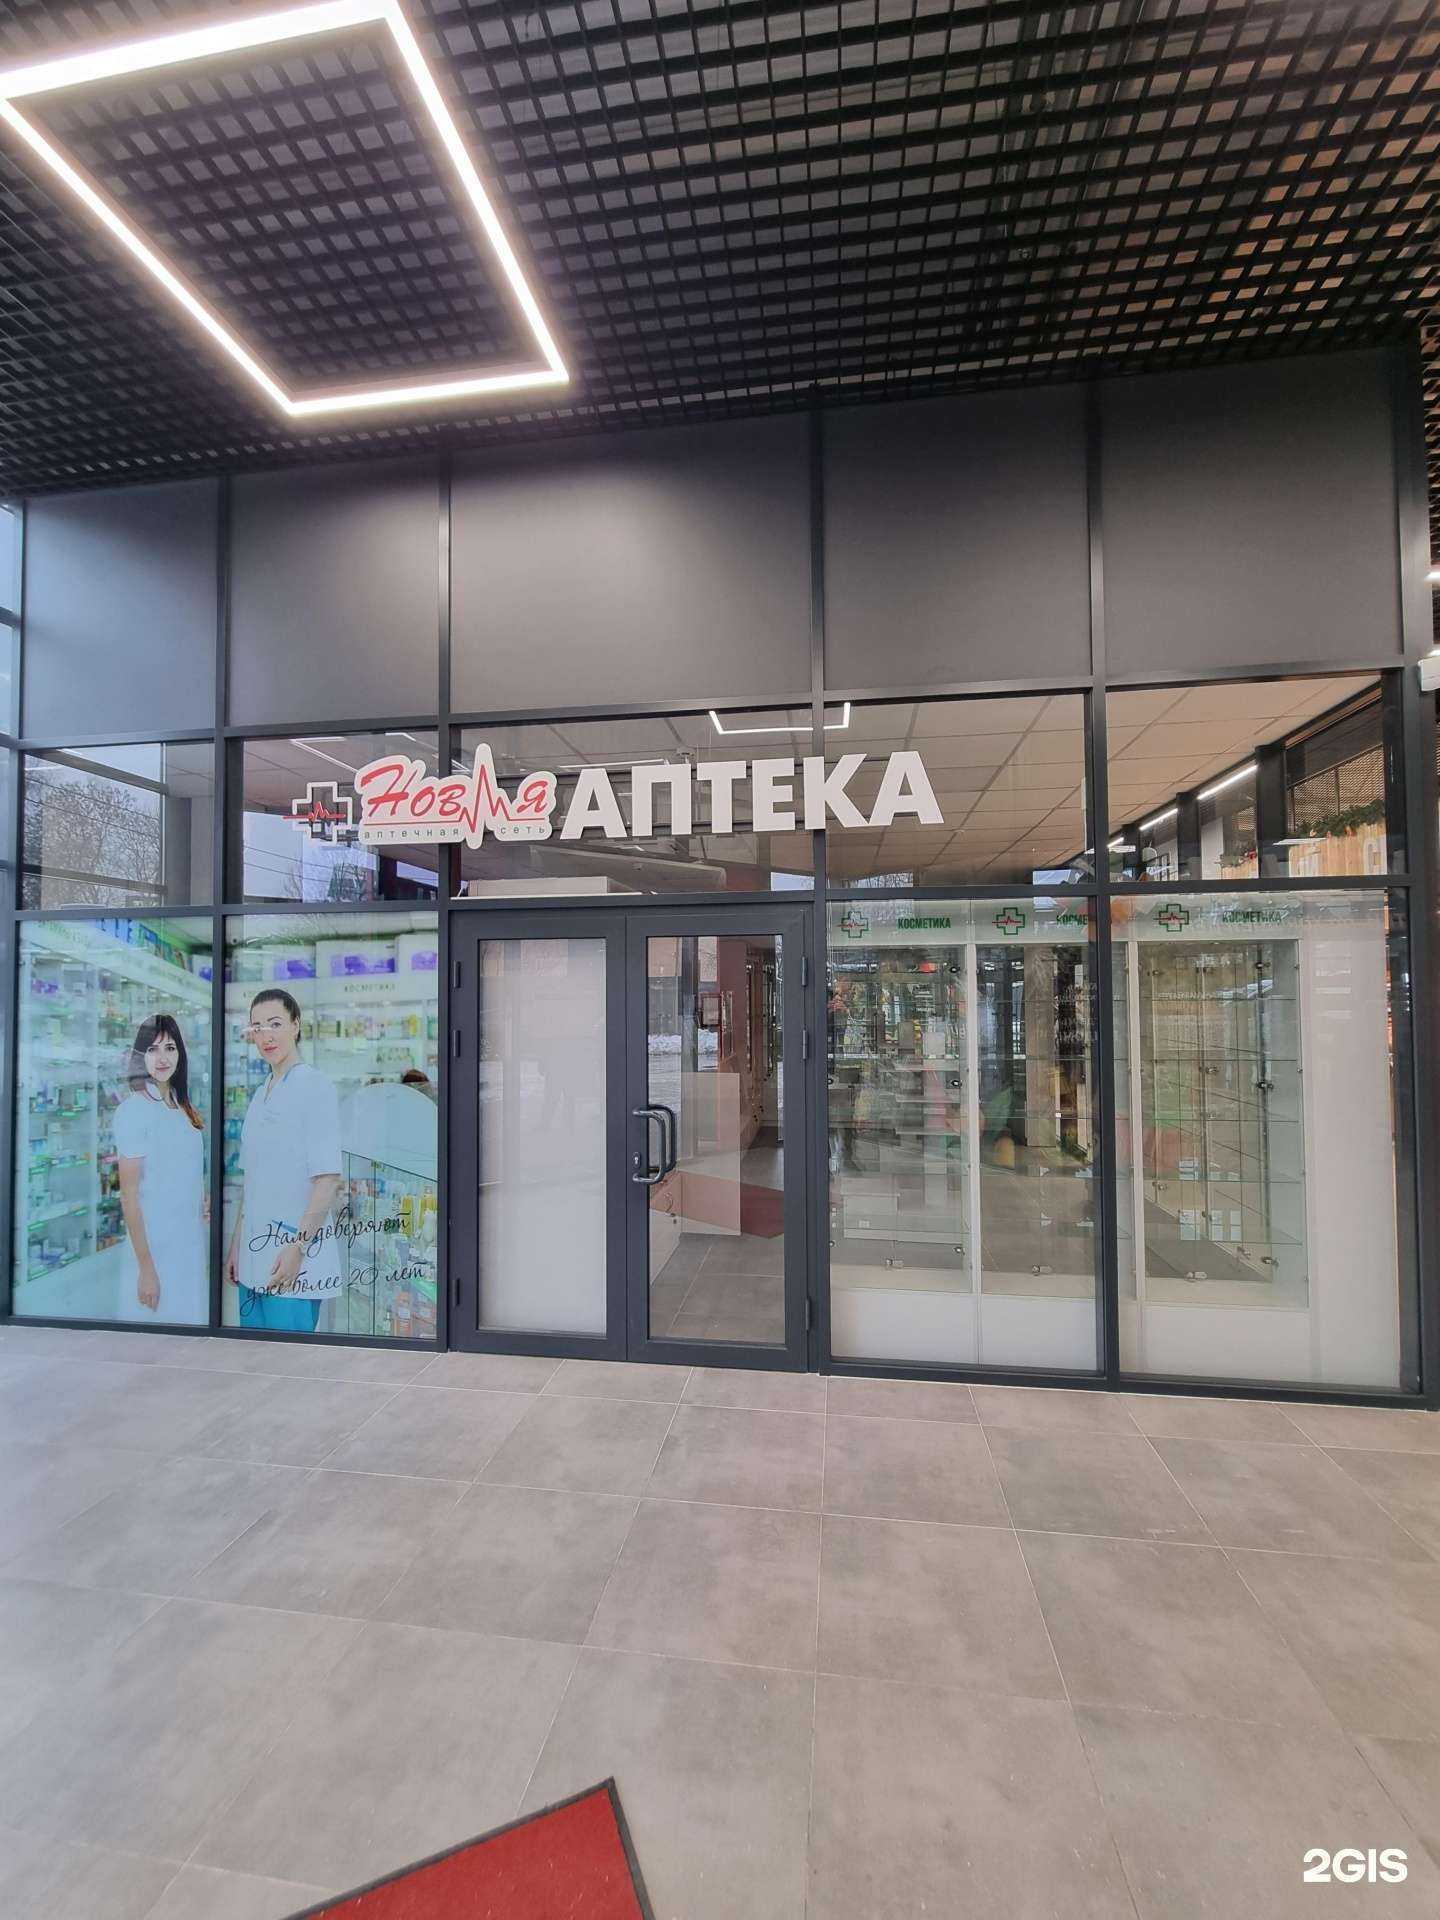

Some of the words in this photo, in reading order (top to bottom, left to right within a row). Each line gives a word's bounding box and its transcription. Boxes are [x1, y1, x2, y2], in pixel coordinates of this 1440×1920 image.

[560, 750, 945, 840] АПТЕКА
[364, 828, 459, 839] аптечная
[500, 826, 545, 835] сеть
[898, 917, 951, 929] КОСМЕТИКА
[1056, 913, 1089, 926] КОСМЕ
[249, 1220, 312, 1252] Нам
[307, 1206, 411, 1258] доверяют
[239, 1283, 288, 1317] уже
[291, 1270, 344, 1296] более
[347, 1266, 379, 1287] 20
[386, 1260, 427, 1283] лет
